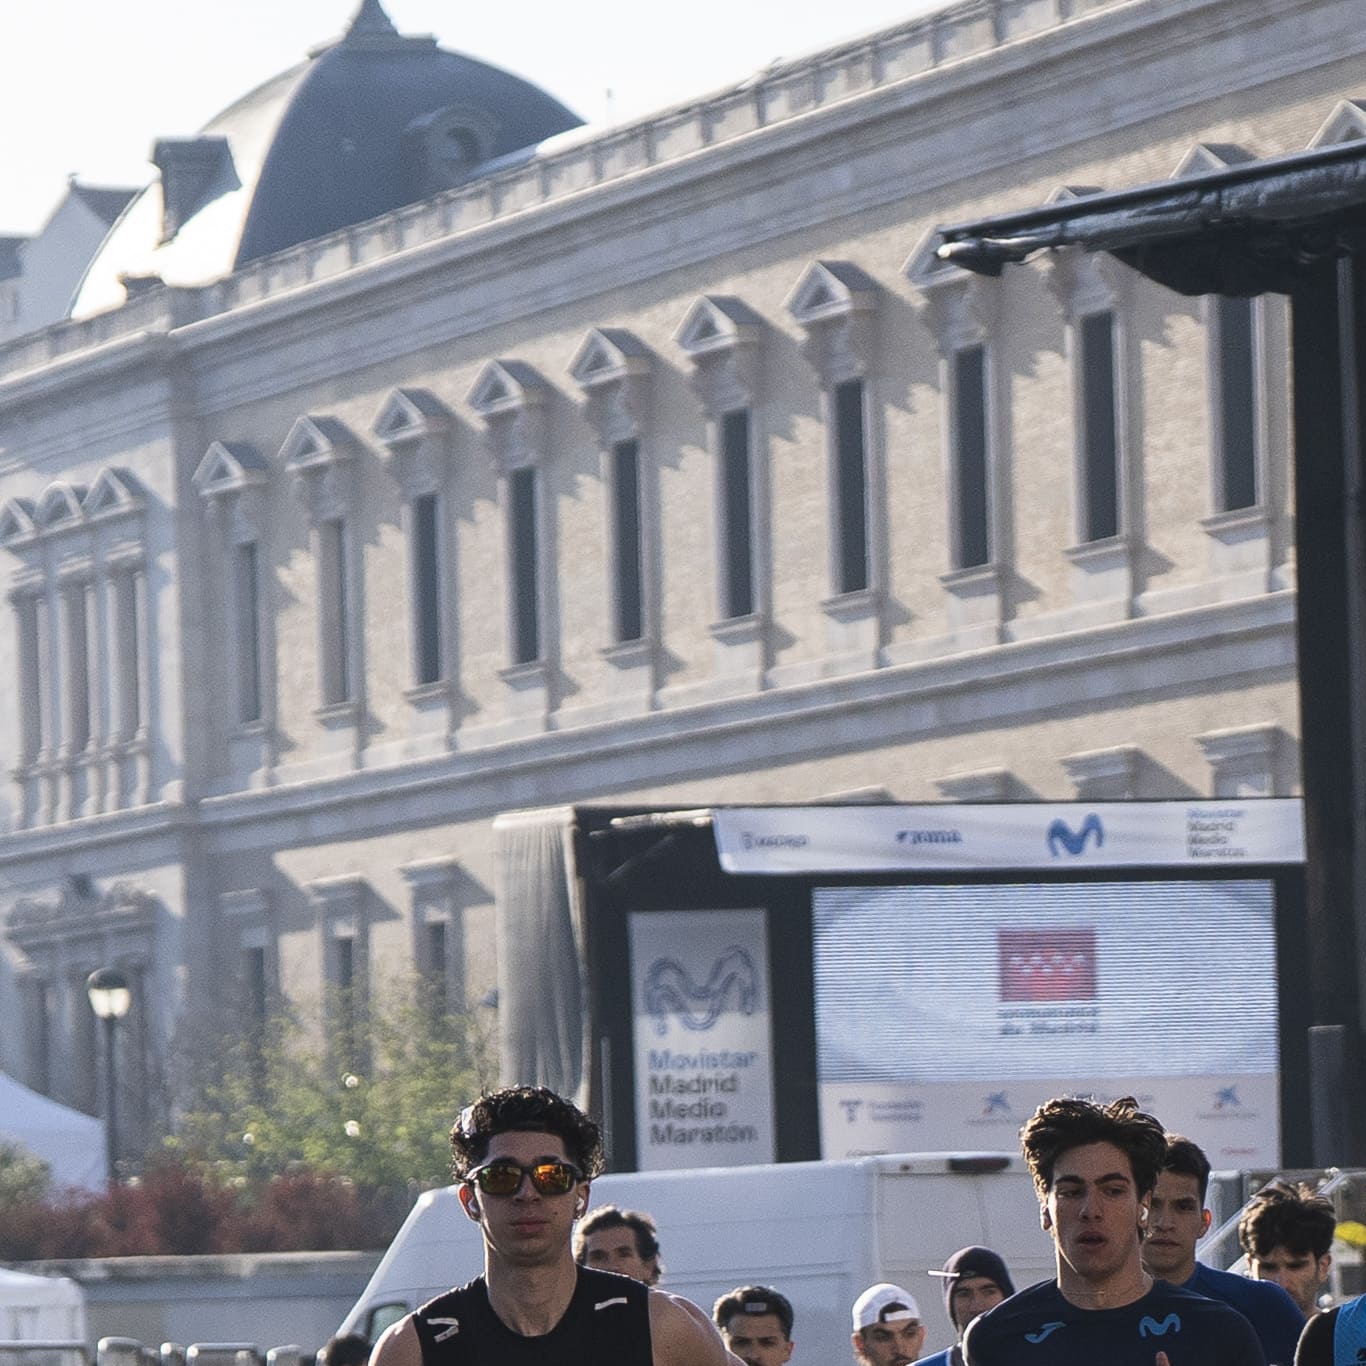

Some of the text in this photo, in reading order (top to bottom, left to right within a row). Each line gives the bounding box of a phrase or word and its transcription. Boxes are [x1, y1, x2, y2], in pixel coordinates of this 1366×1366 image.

[650, 1050, 758, 1069] Movistar
[650, 1072, 739, 1094] Madrid
[650, 1097, 728, 1120] Medio
[650, 1120, 759, 1144] Maratón
